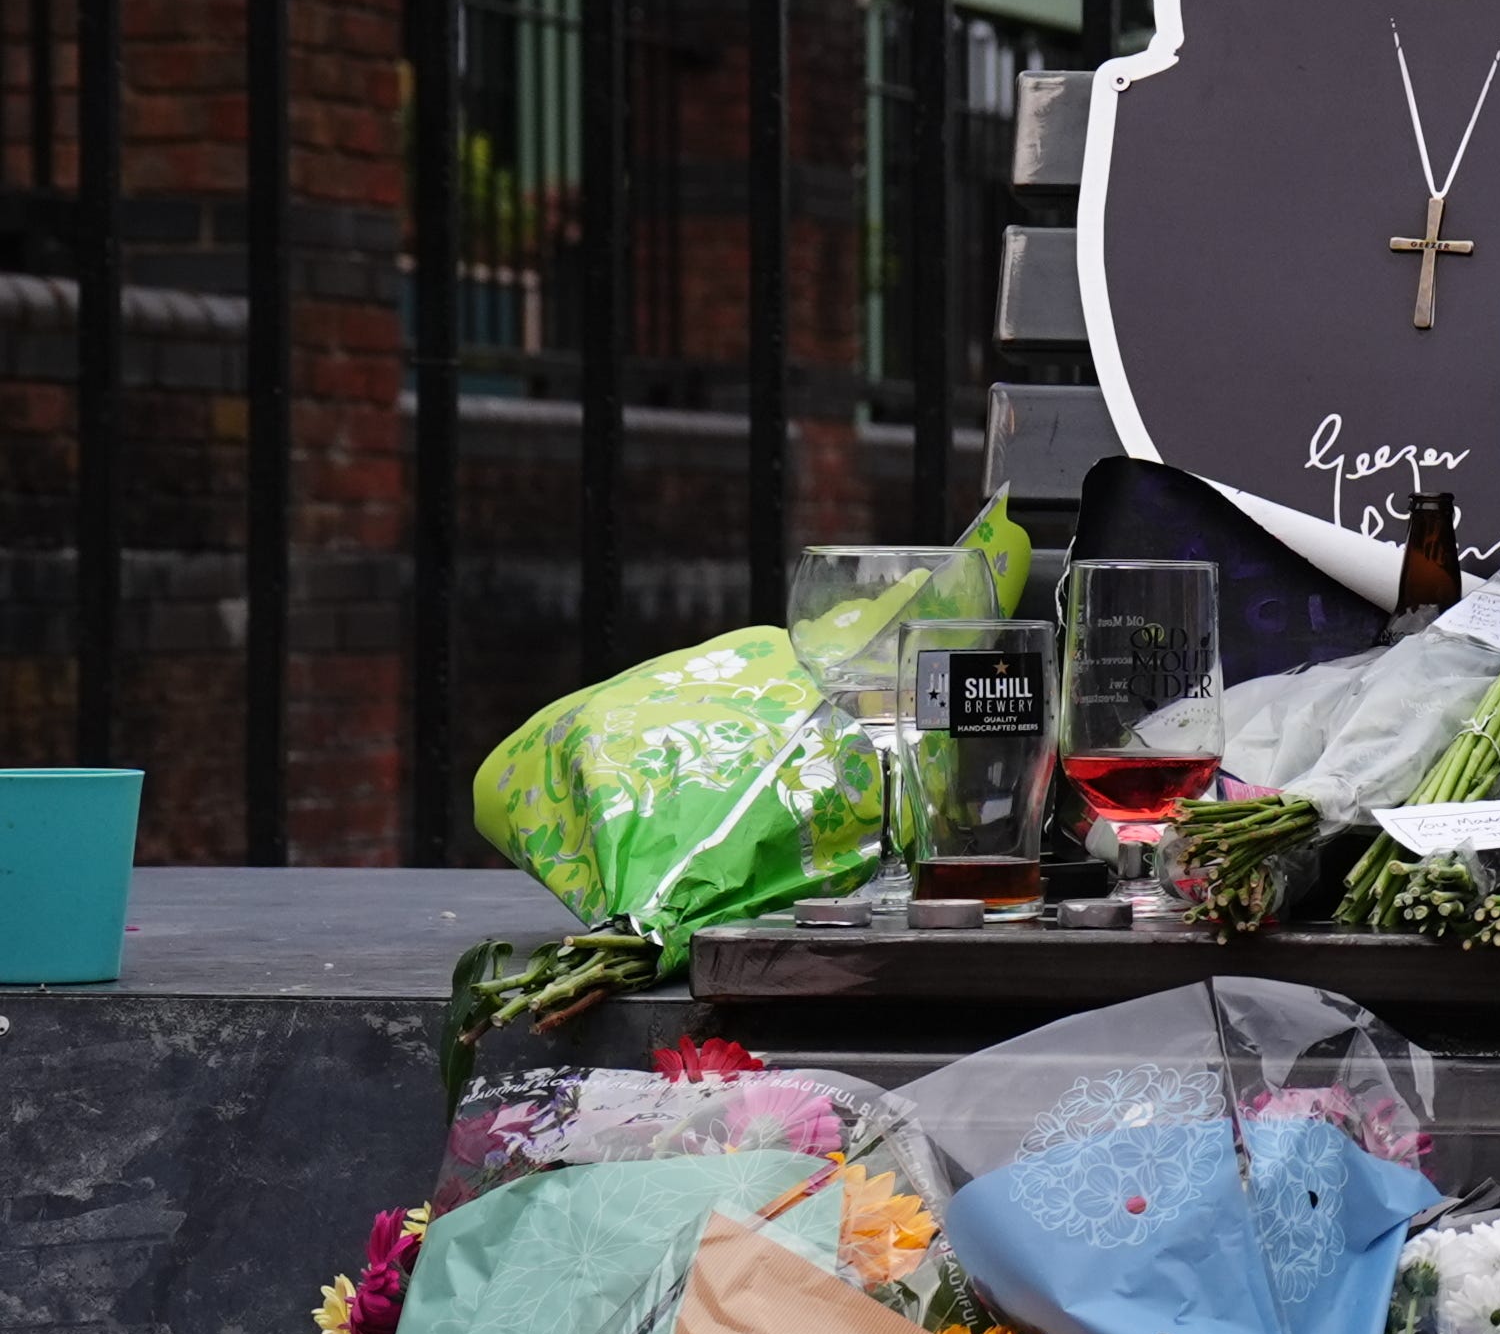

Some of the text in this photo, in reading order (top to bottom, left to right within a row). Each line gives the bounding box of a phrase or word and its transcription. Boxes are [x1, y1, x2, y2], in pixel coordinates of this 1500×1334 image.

[1130, 627, 1188, 650] OLD
[965, 677, 1033, 699] SILHILL
[1128, 674, 1213, 699] CIDER
[964, 699, 1033, 713] BREWERY
[957, 723, 1039, 732] HANDCRAFTED BEERS
[983, 715, 1018, 723] QUALITY
[770, 1079, 856, 1110] BEAUTIFUL
